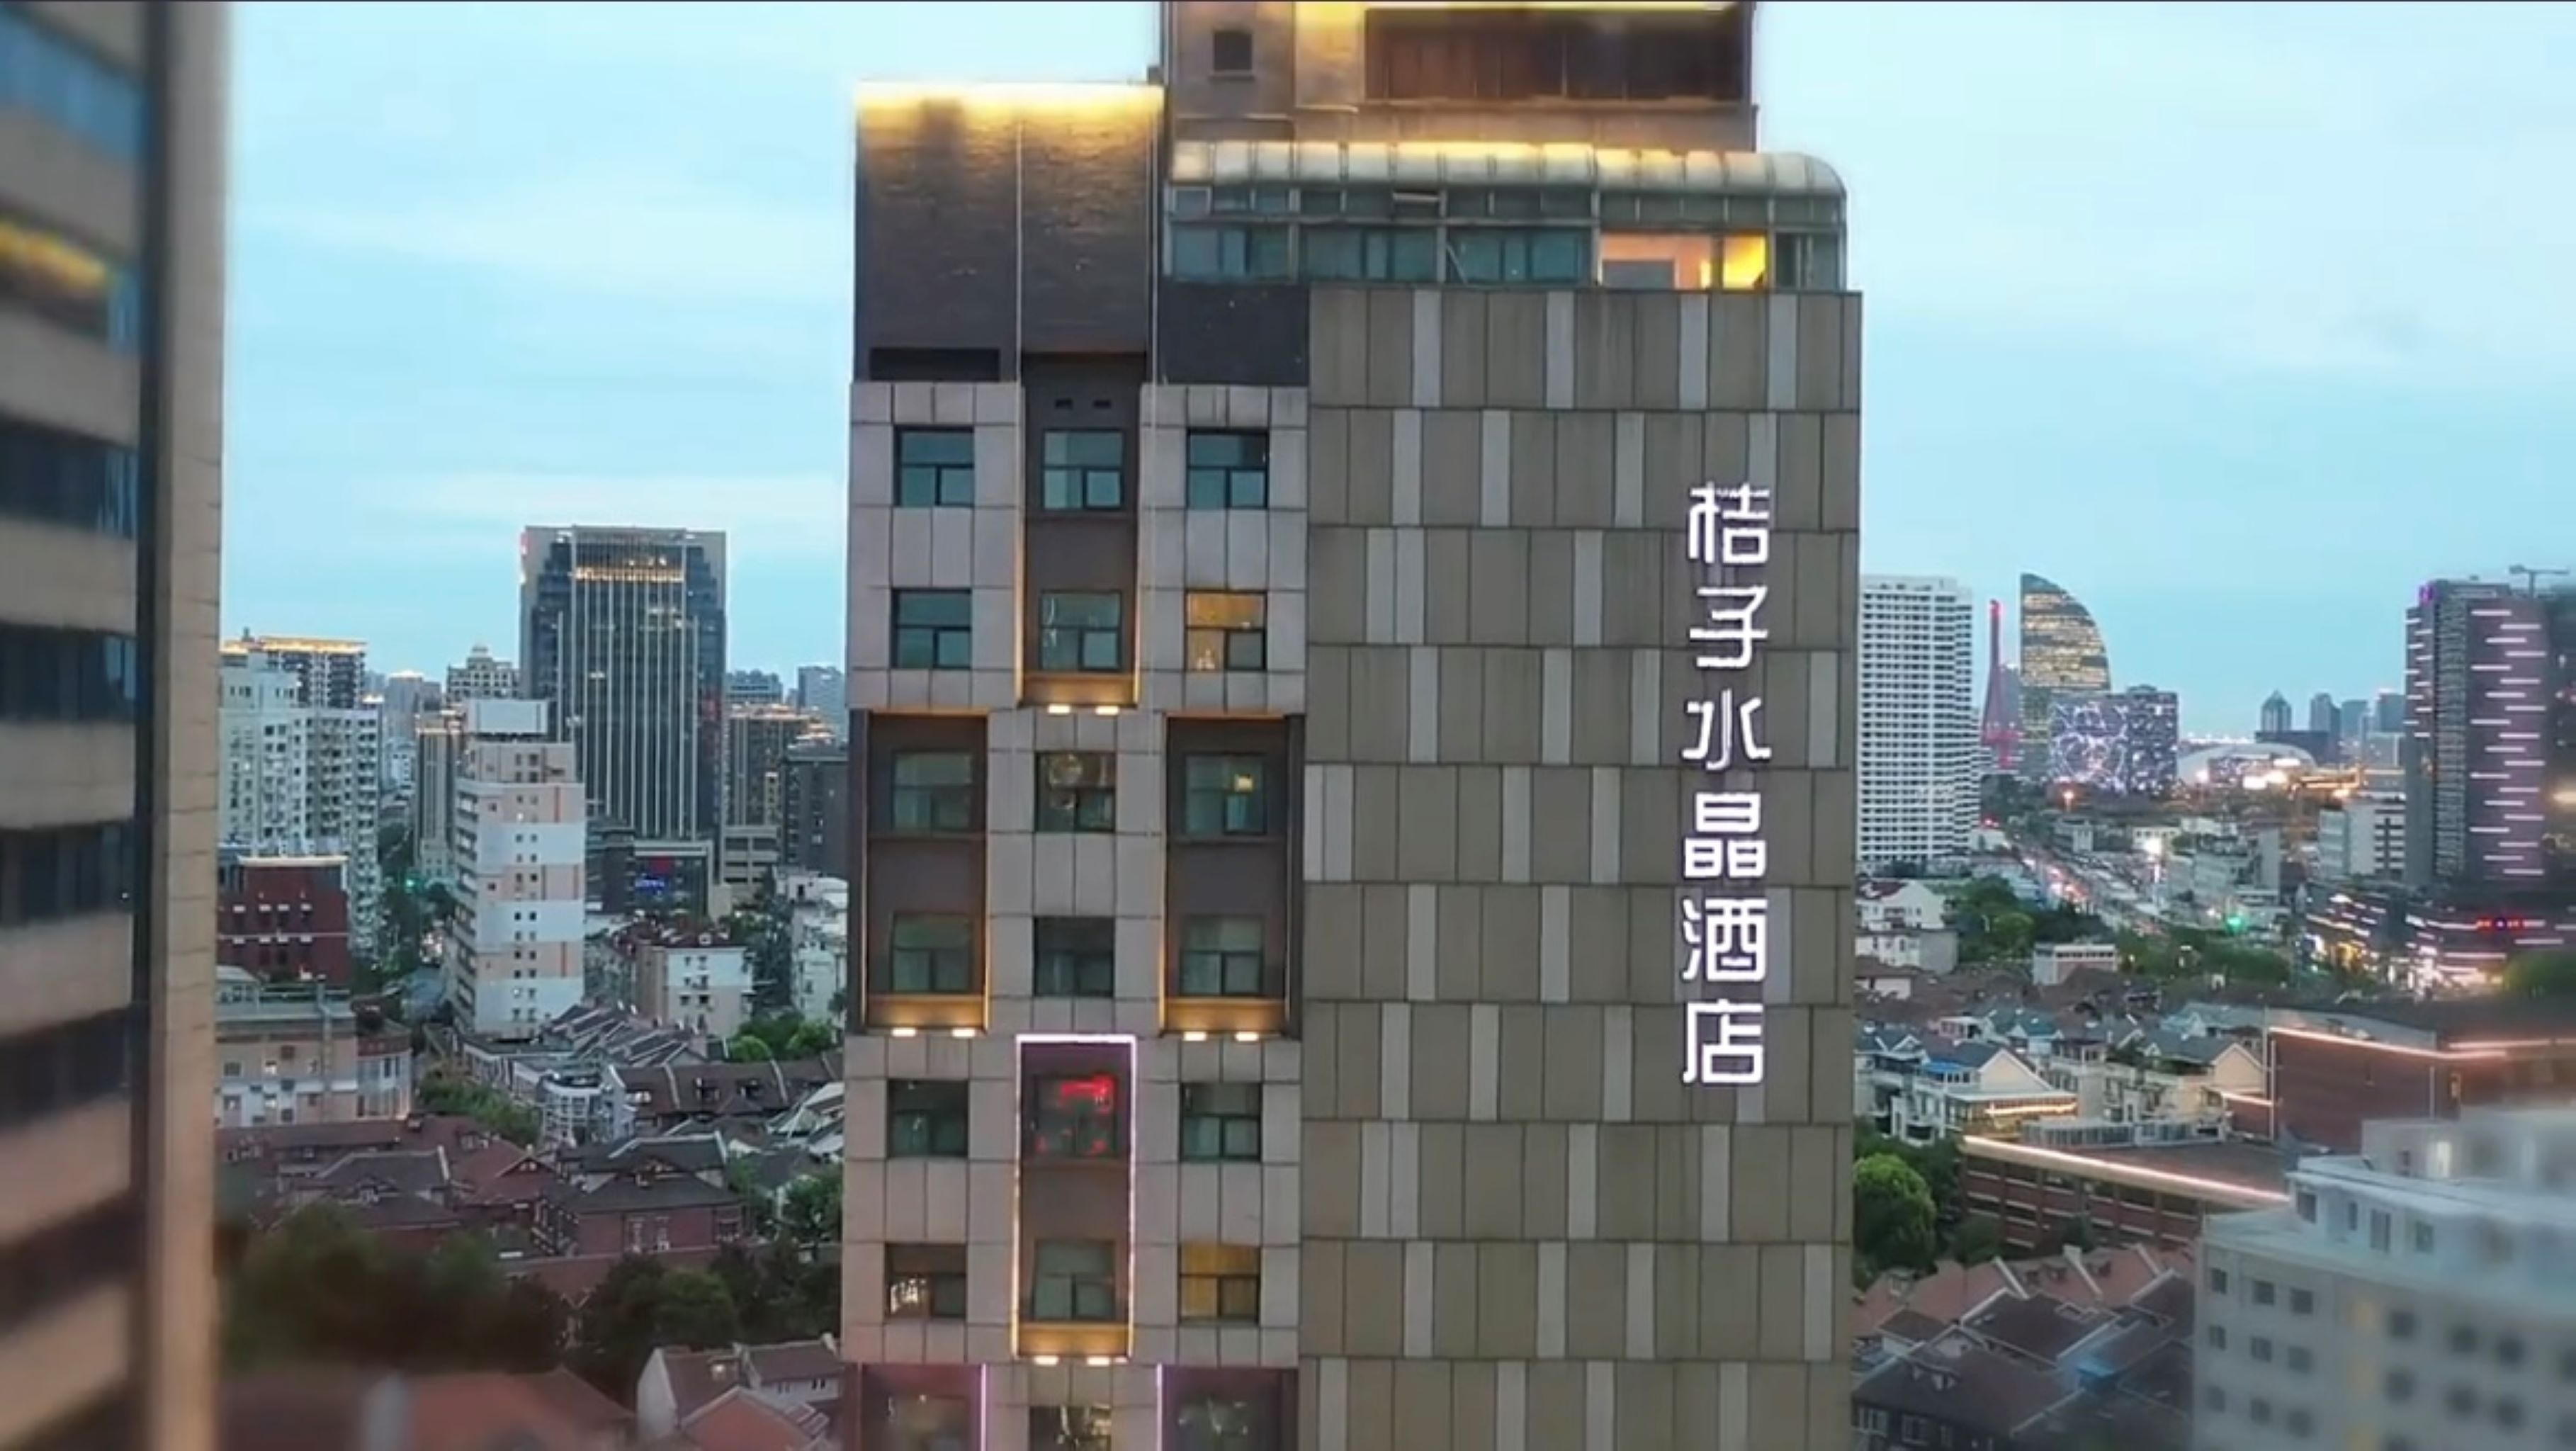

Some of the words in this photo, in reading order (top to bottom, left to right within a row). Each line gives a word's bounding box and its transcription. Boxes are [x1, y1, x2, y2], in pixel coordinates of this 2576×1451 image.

[1682, 482, 1771, 1083] 桔子水晶酒店
